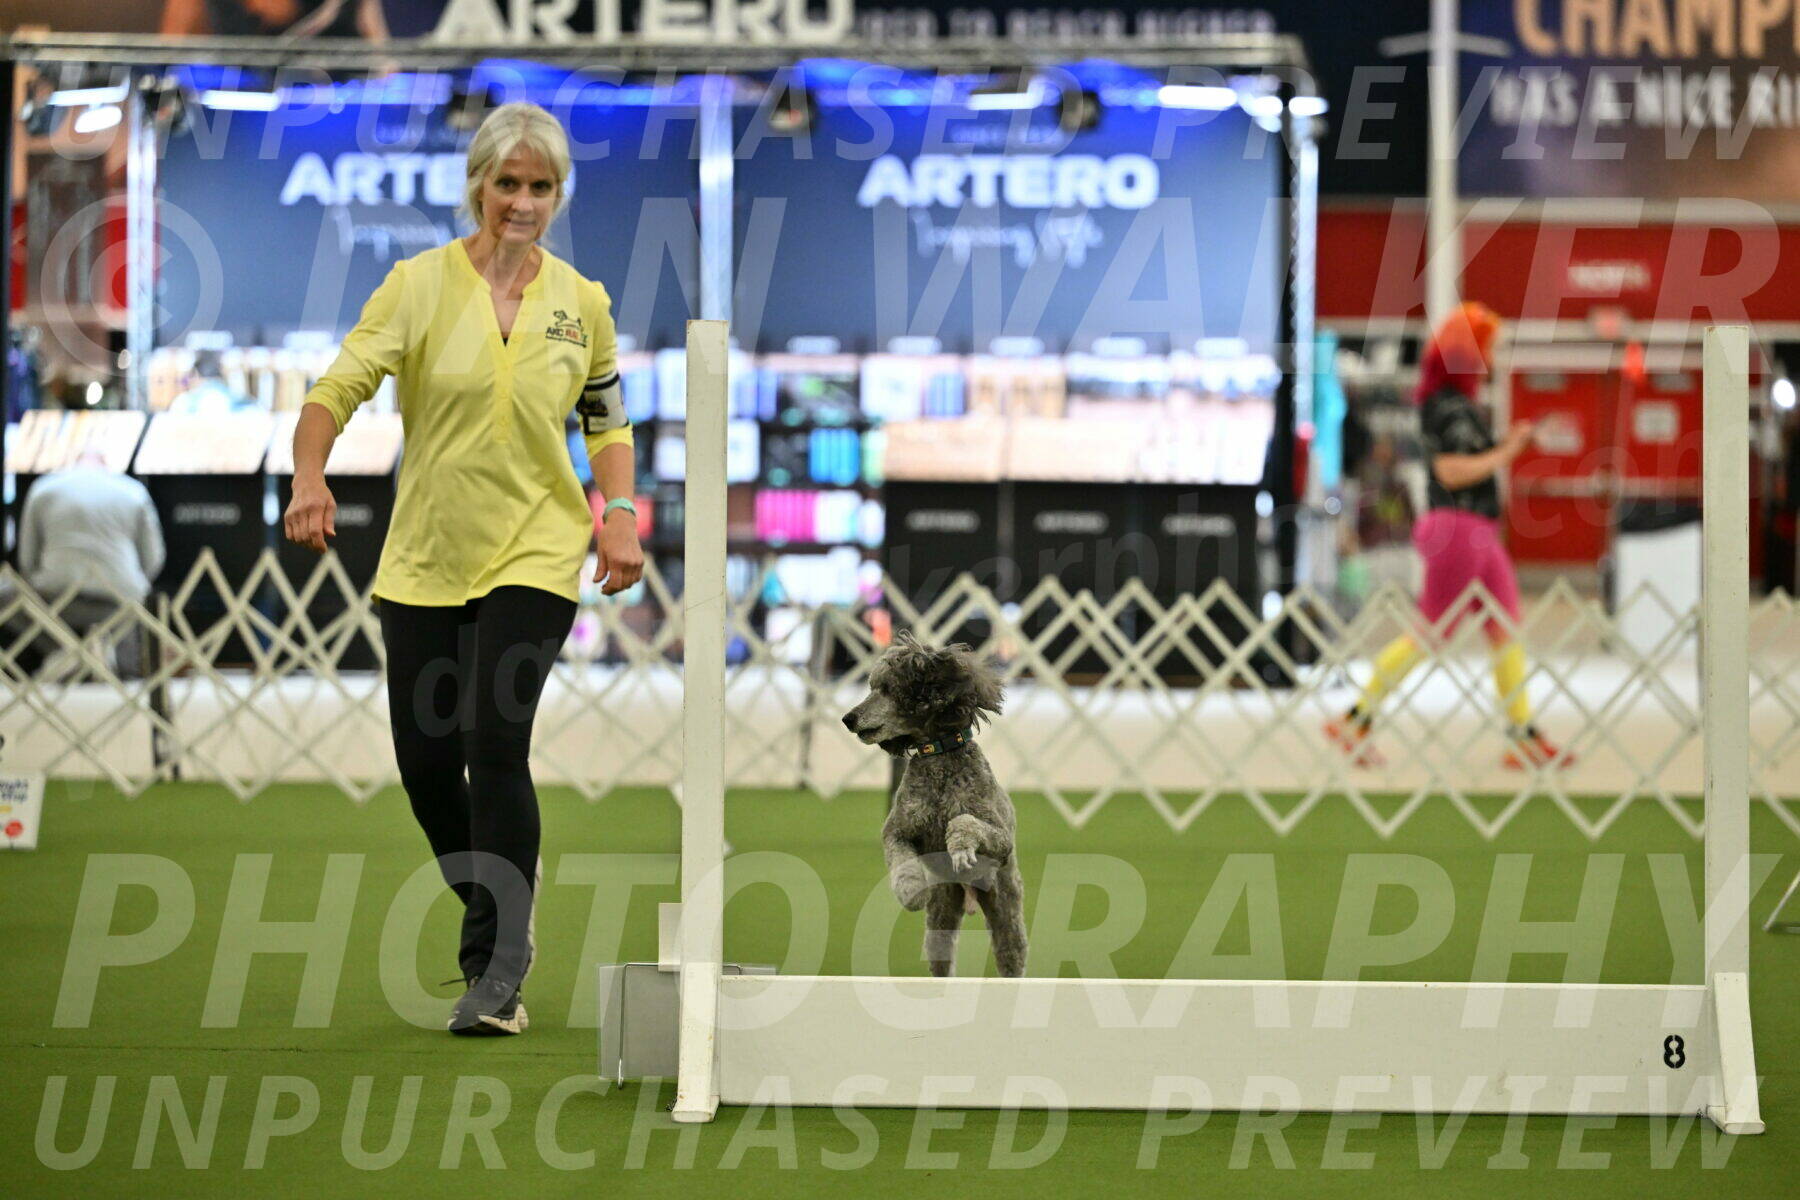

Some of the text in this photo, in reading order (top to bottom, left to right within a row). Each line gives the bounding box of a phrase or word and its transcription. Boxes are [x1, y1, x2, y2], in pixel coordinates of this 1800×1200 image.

[1513, 0, 1800, 58] CHAMP
[858, 153, 1160, 209] ARTERO
[1663, 1034, 1686, 1069] 8
